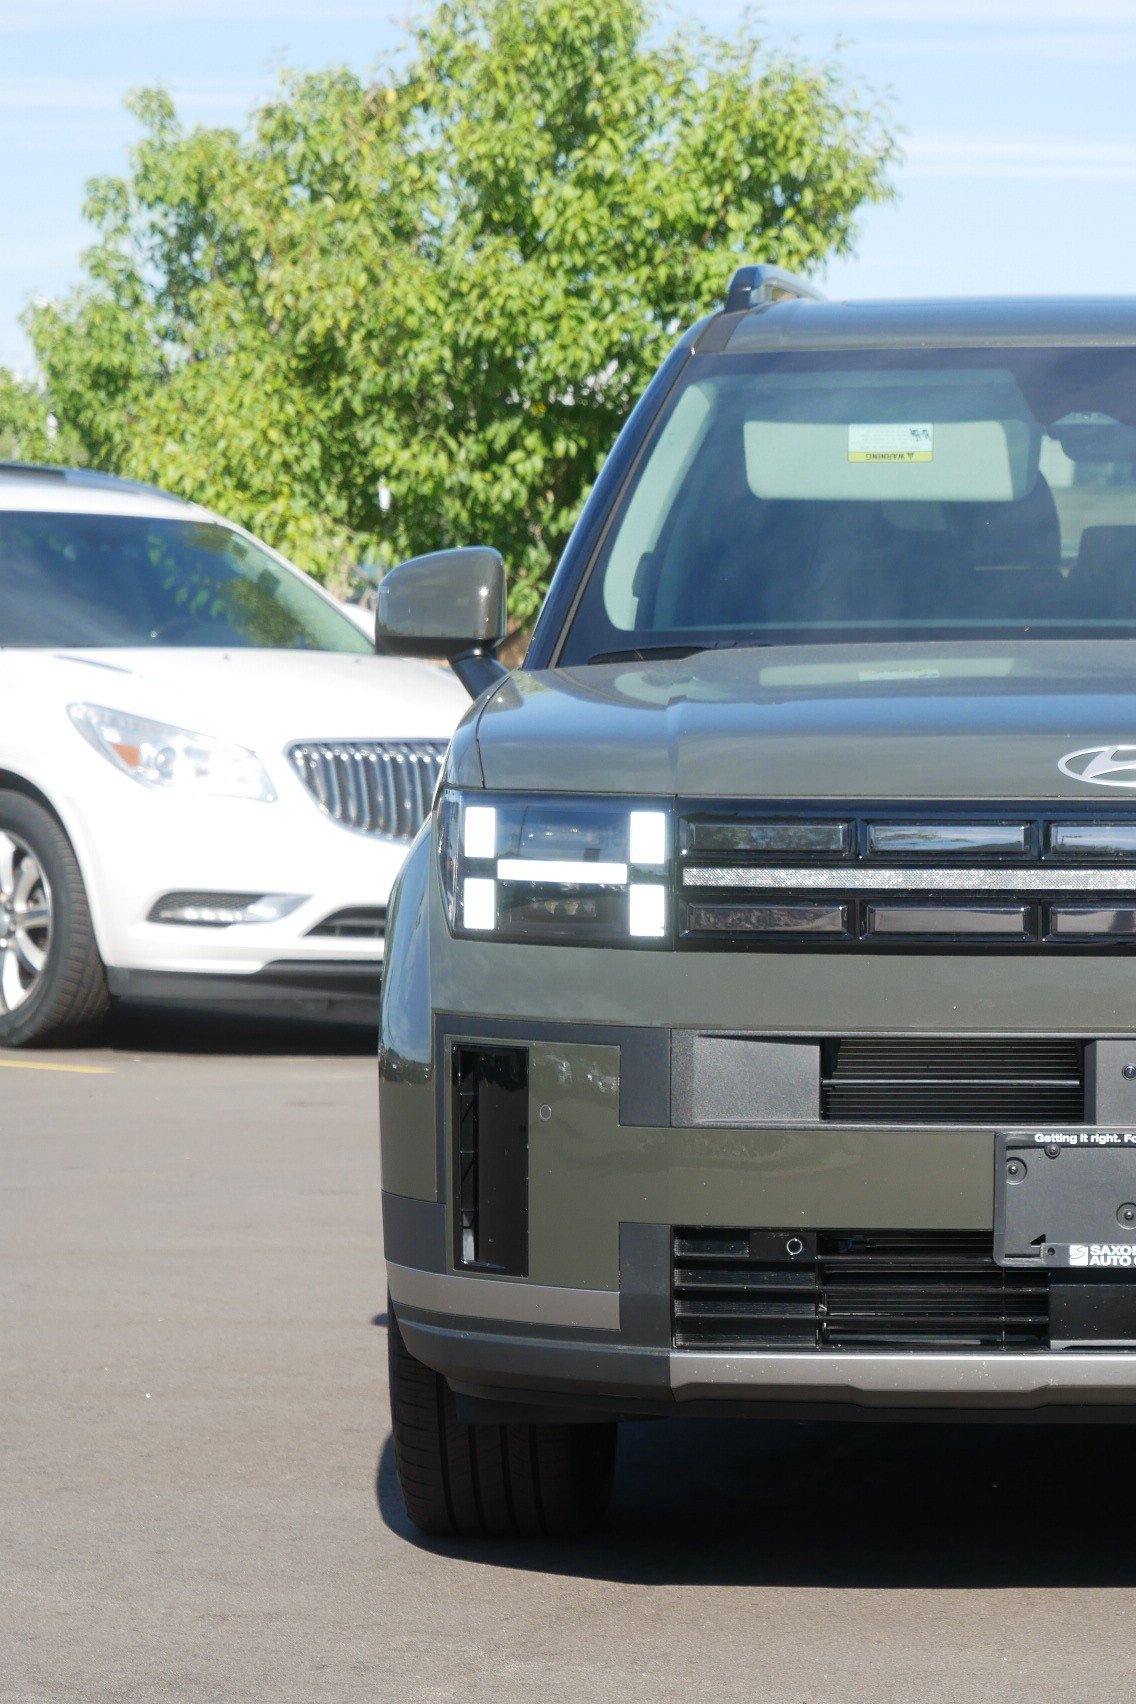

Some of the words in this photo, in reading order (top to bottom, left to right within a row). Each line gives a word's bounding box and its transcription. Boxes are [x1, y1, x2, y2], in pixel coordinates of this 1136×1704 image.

[865, 453, 906, 461] WARNING
[1034, 1133, 1078, 1145] Getting
[1090, 1133, 1121, 1145] right.
[1089, 1255, 1132, 1266] AUTO
